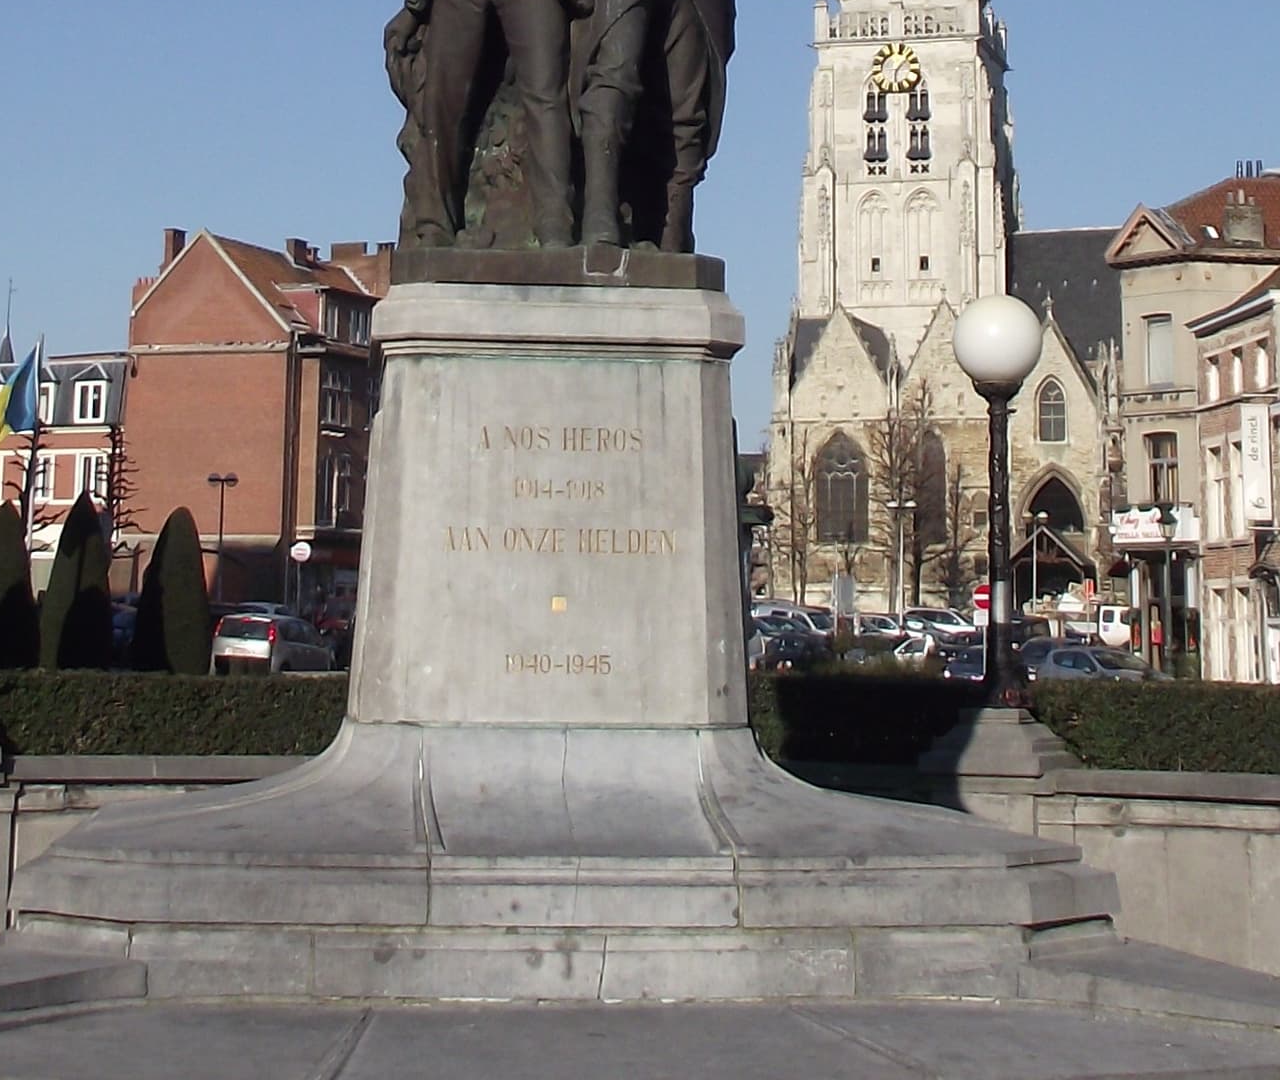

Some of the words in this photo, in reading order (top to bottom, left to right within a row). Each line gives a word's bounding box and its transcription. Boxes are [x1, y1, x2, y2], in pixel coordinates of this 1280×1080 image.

[480, 425, 491, 450] A
[503, 425, 551, 451] NOS
[561, 426, 643, 452] HEROS
[513, 477, 606, 501] 1914-1918
[443, 526, 491, 553] AAN
[503, 527, 567, 553] ONZE
[577, 528, 678, 555] HELDEN
[504, 653, 612, 675] 1940-1945
